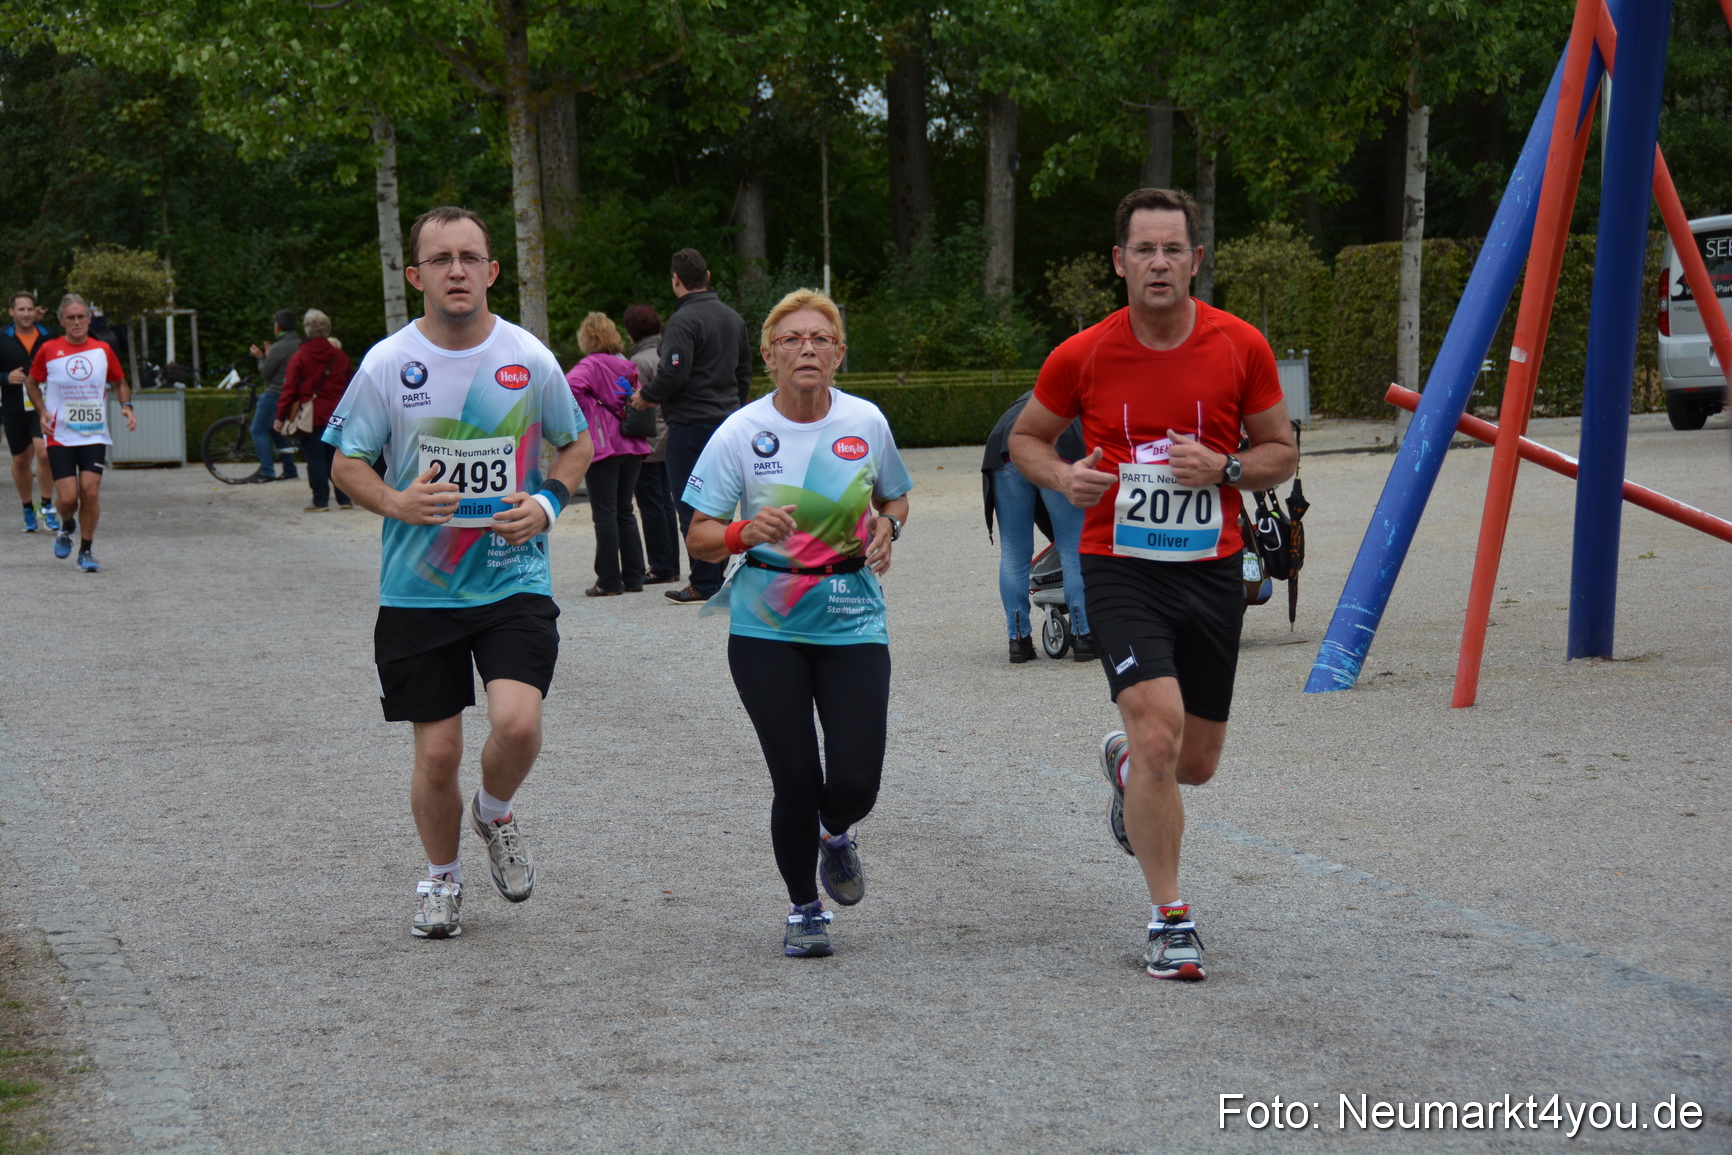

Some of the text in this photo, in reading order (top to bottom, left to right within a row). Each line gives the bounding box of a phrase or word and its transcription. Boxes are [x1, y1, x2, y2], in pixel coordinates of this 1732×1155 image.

[500, 371, 528, 384] Hervis
[402, 392, 431, 403] PARTL
[403, 400, 432, 409] Neumarkt
[69, 408, 102, 422] 2055
[421, 444, 500, 457] PARTL Neumarkt
[837, 442, 865, 455] Hervis
[1152, 443, 1175, 456] DEH
[753, 461, 783, 471] PARTL
[429, 459, 508, 494] 2493
[1122, 473, 1154, 483] PARTL
[1126, 488, 1212, 525] 2070
[1147, 533, 1189, 548] Oliver
[829, 578, 851, 594] 16.
[826, 605, 865, 615] Stadtlauf
